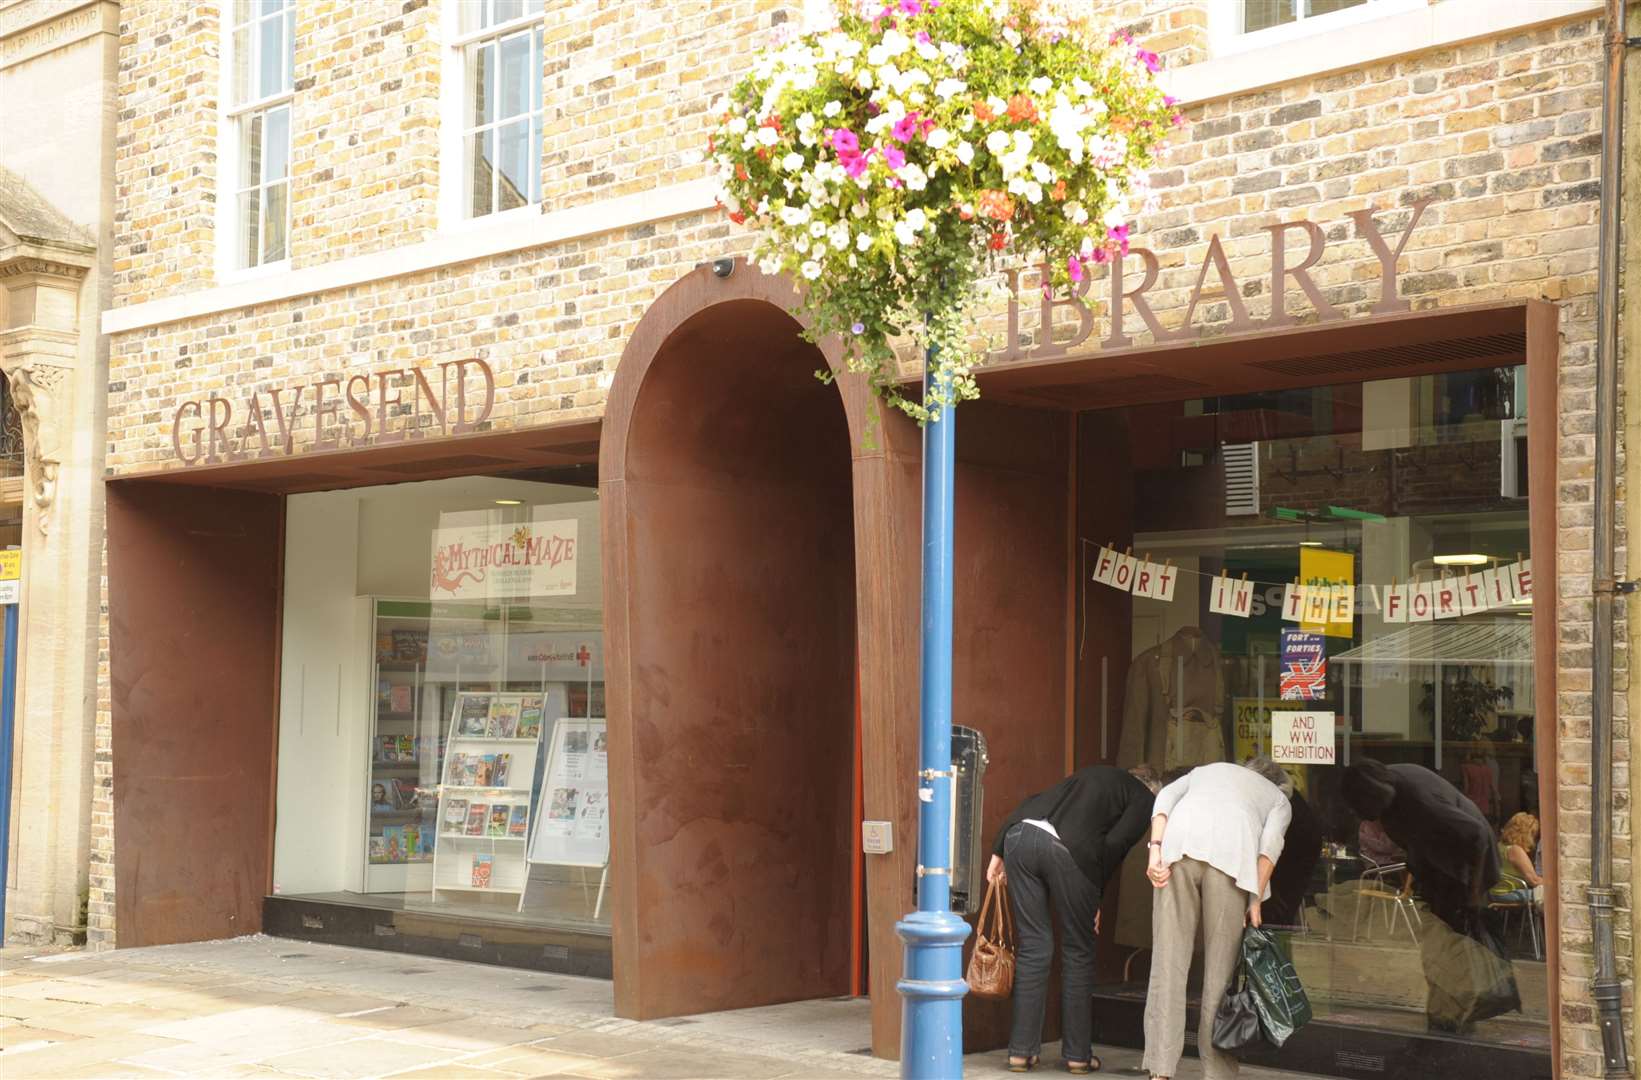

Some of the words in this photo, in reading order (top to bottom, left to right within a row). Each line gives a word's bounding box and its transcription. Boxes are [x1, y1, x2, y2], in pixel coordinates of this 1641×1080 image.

[990, 196, 1438, 363] IBRARY
[172, 358, 495, 466] GRAVESEND
[447, 542, 521, 572] MYTHICAL
[525, 534, 575, 568] MAZE
[1098, 558, 1151, 596] FORT
[1218, 587, 1248, 612] IN
[1290, 594, 1348, 618] THE
[1286, 633, 1310, 642] FORT
[1286, 644, 1321, 653] FORTIES
[1292, 716, 1315, 730] AND
[1289, 731, 1318, 744] WWI
[1273, 745, 1333, 759] EXHIBITION
